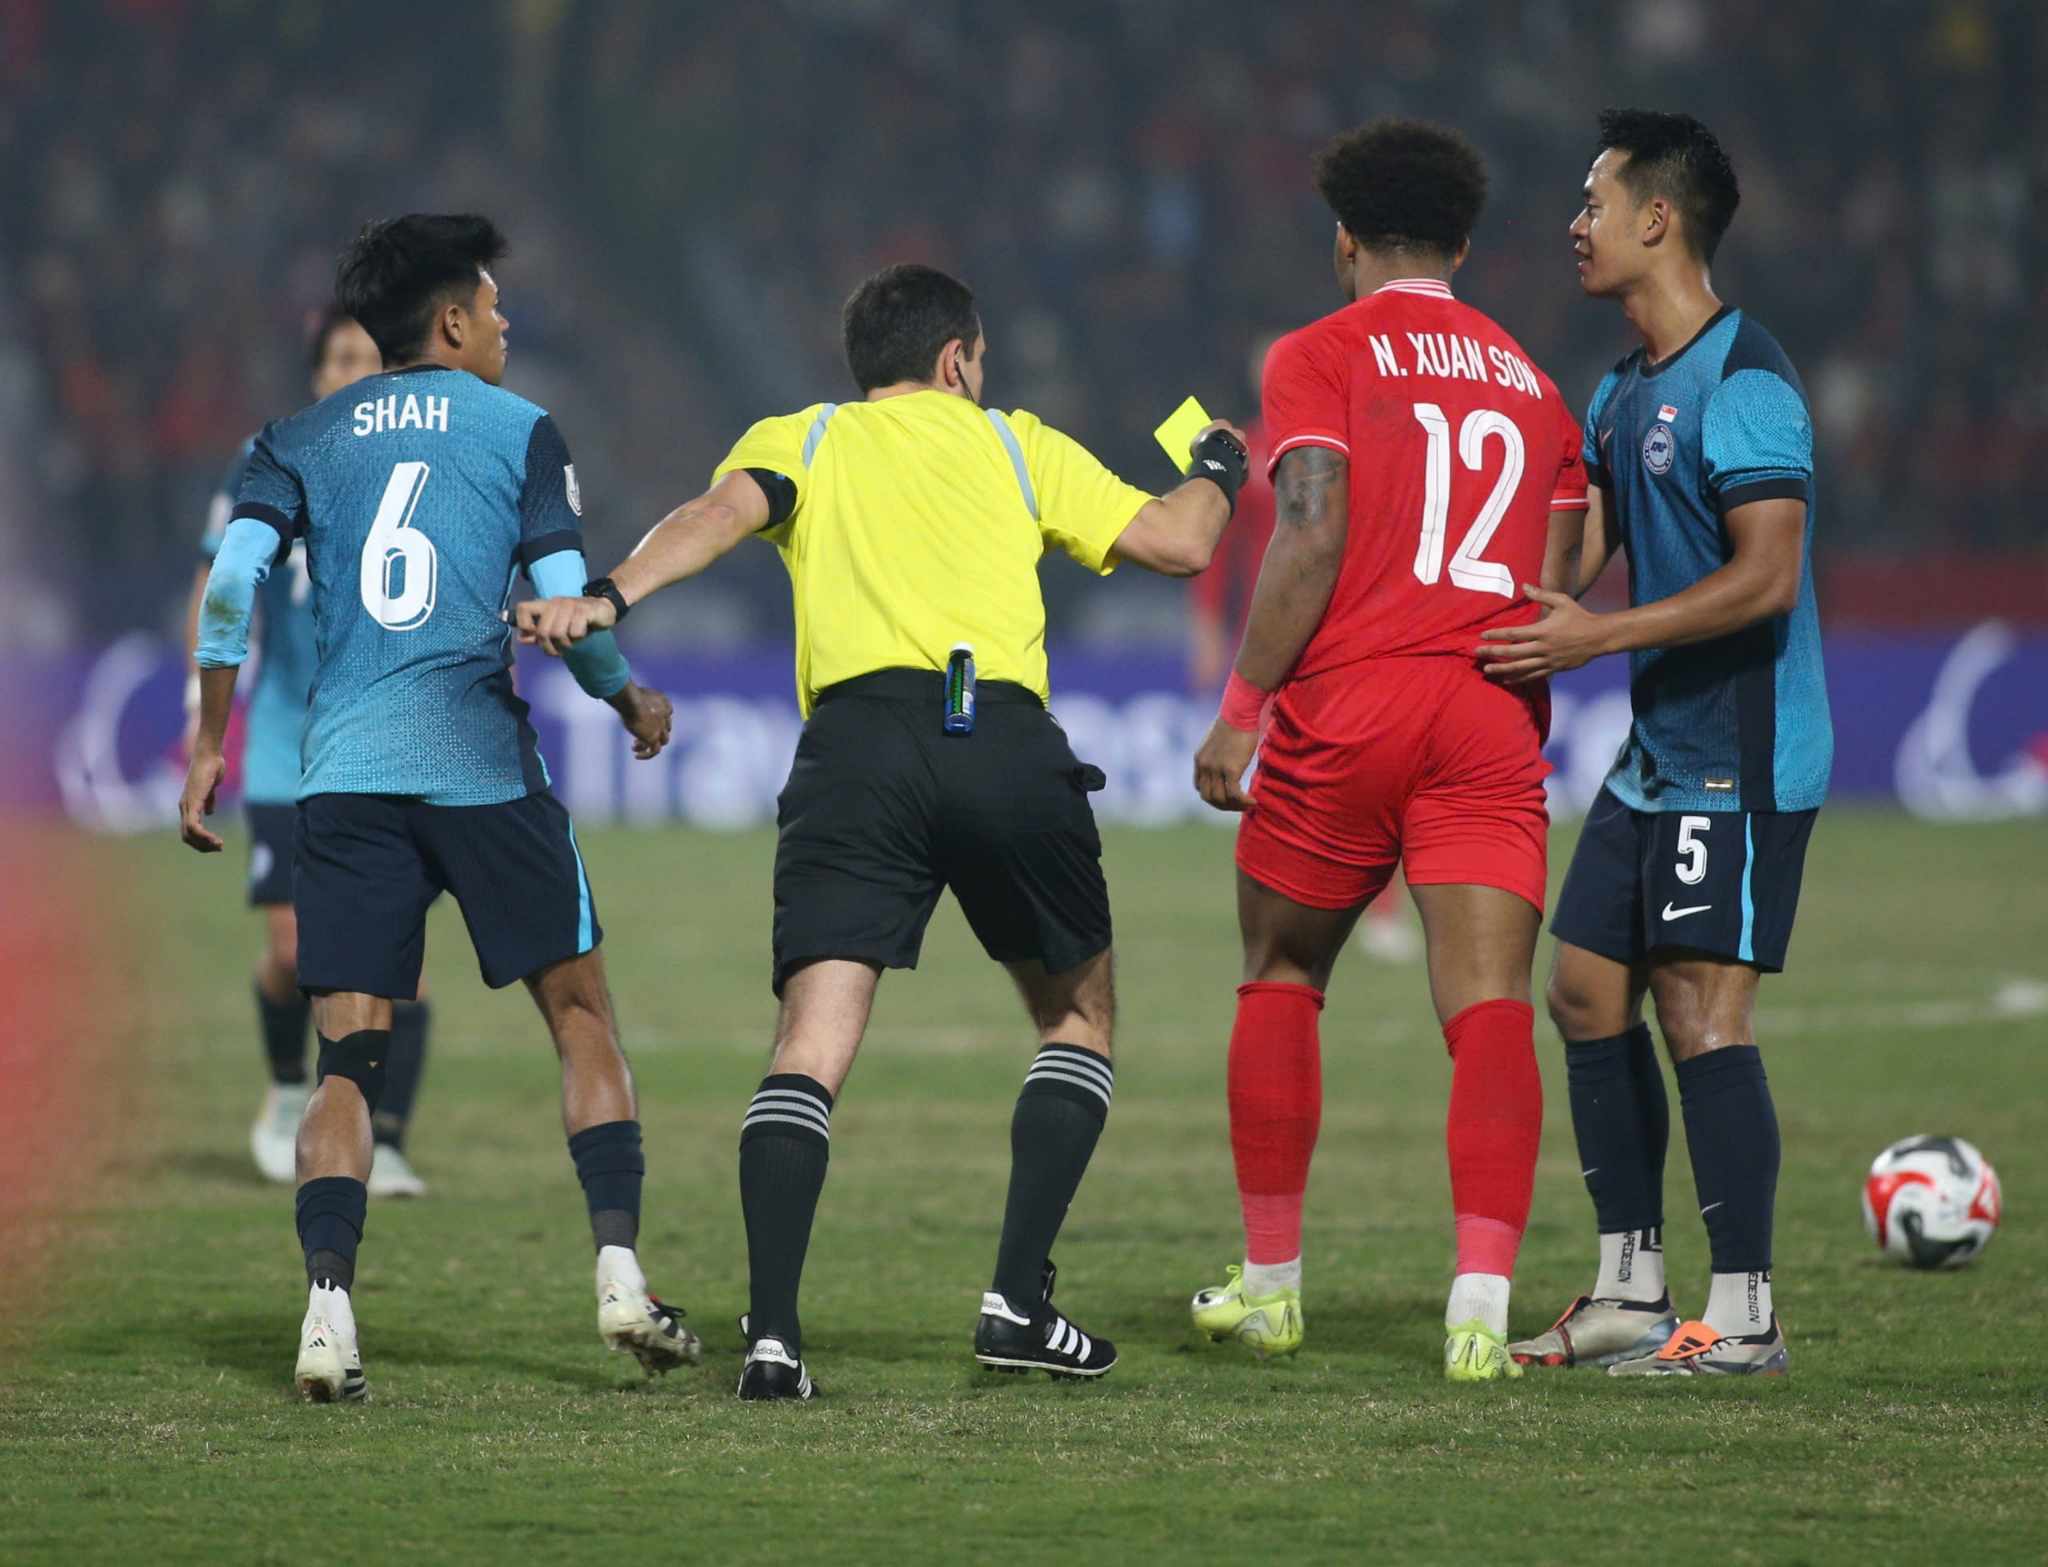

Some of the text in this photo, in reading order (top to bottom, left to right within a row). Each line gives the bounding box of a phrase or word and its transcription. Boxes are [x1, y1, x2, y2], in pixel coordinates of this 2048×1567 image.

[1368, 332, 1542, 399] N. XUAN SON
[353, 394, 449, 437] SHAH
[1412, 403, 1525, 599] 12
[360, 461, 438, 631] 6
[1675, 816, 1711, 885] 5
